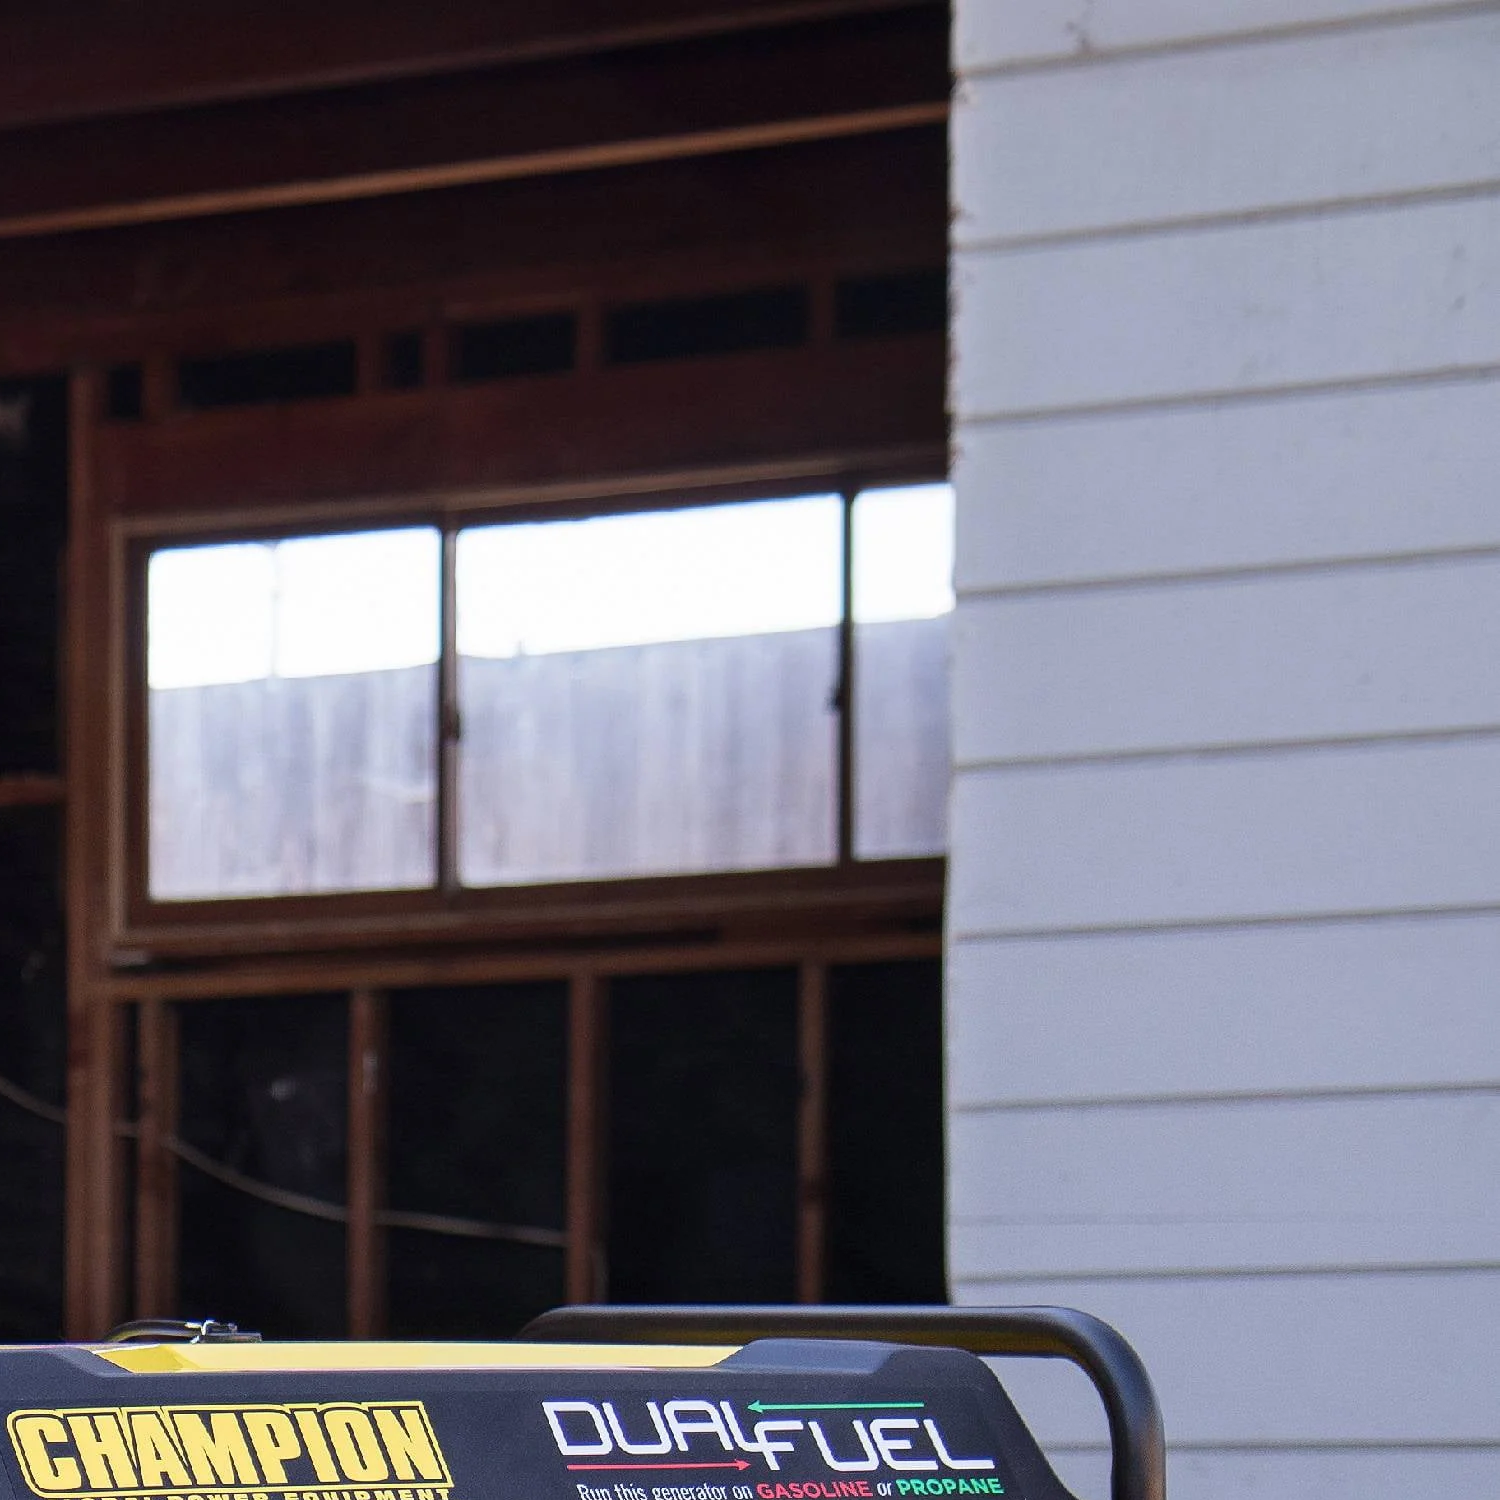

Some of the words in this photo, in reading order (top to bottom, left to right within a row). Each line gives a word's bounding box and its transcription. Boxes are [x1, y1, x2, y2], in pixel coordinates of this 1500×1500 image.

[11, 1403, 450, 1494] CHAMPION
[732, 1484, 754, 1500] on
[756, 1480, 873, 1499] GASOLINE
[876, 1481, 894, 1497] or
[896, 1476, 1005, 1496] PROPANE
